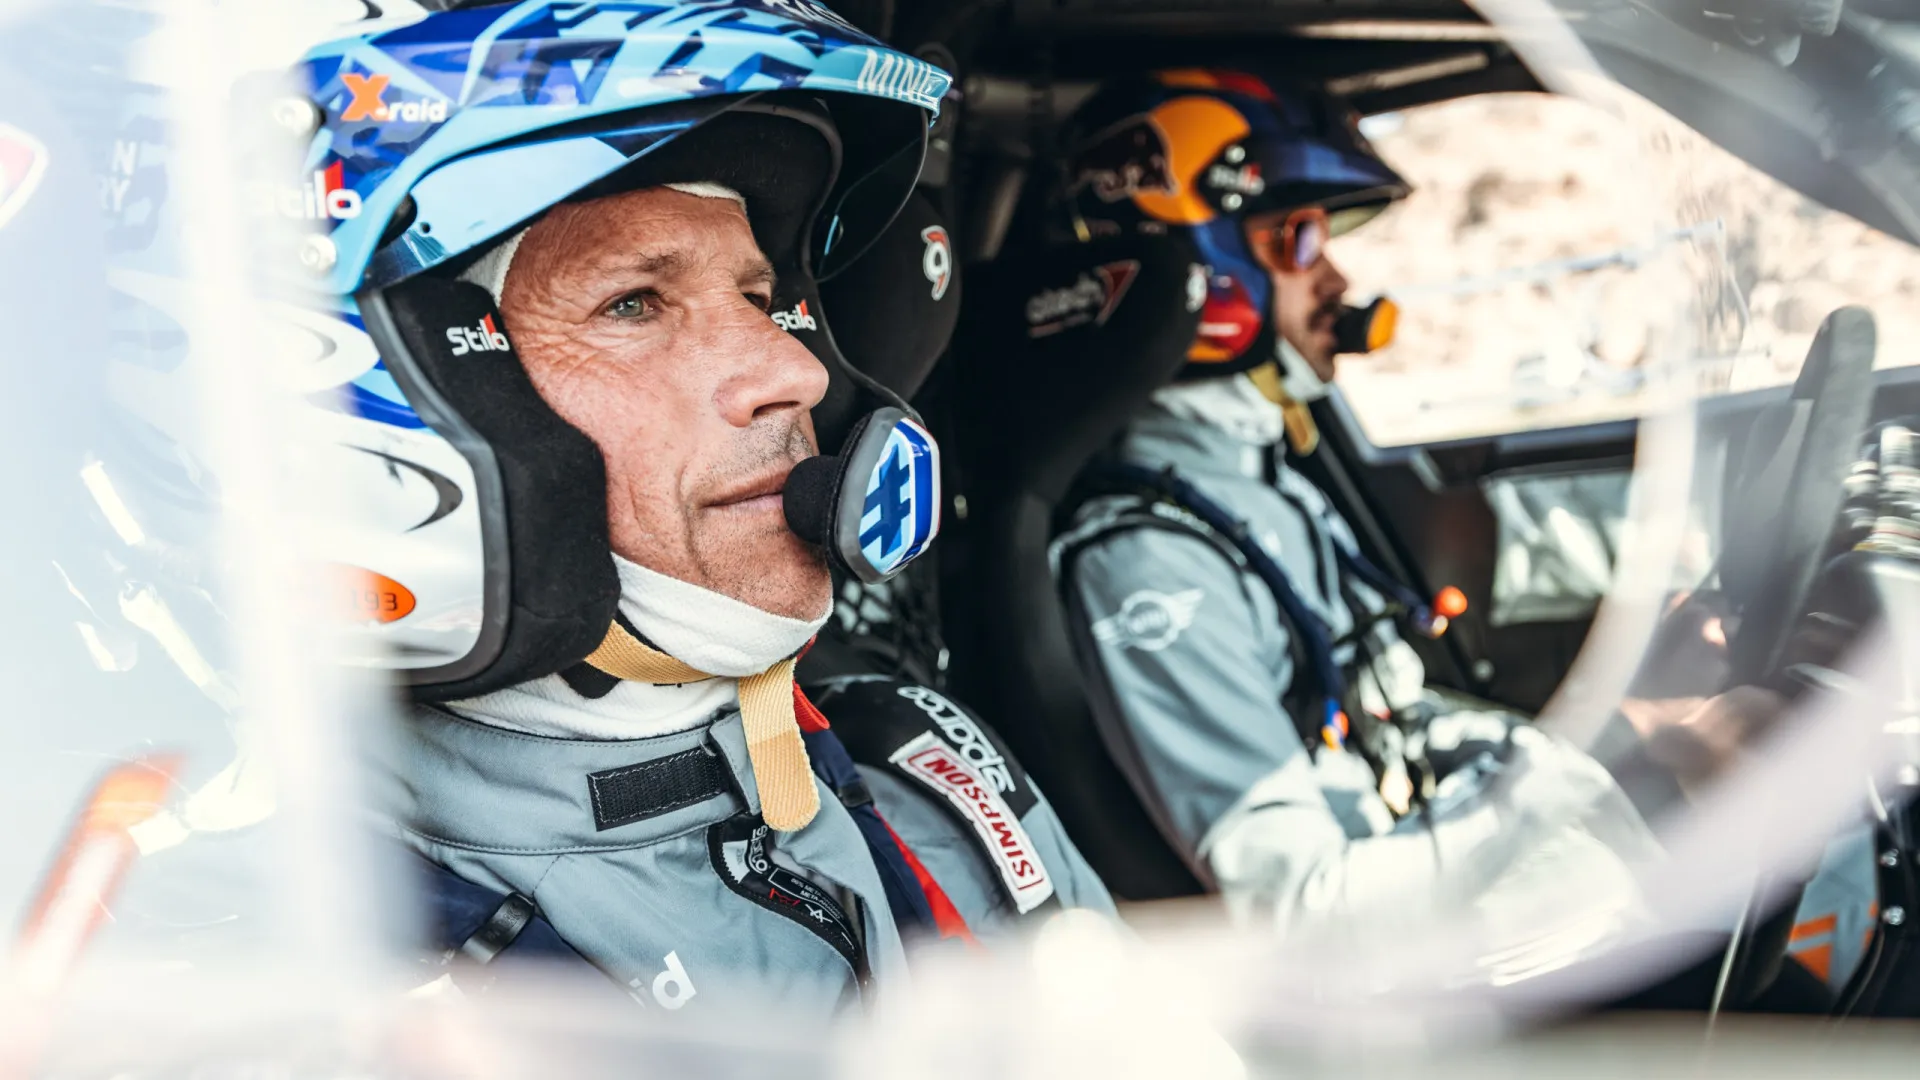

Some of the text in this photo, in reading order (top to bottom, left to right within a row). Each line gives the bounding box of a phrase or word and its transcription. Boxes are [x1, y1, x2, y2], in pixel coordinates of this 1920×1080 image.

[446, 312, 510, 356] Stilo
[770, 298, 817, 332] Stilo
[897, 685, 1014, 793] sparco
[924, 757, 1035, 878] SIMPSON
